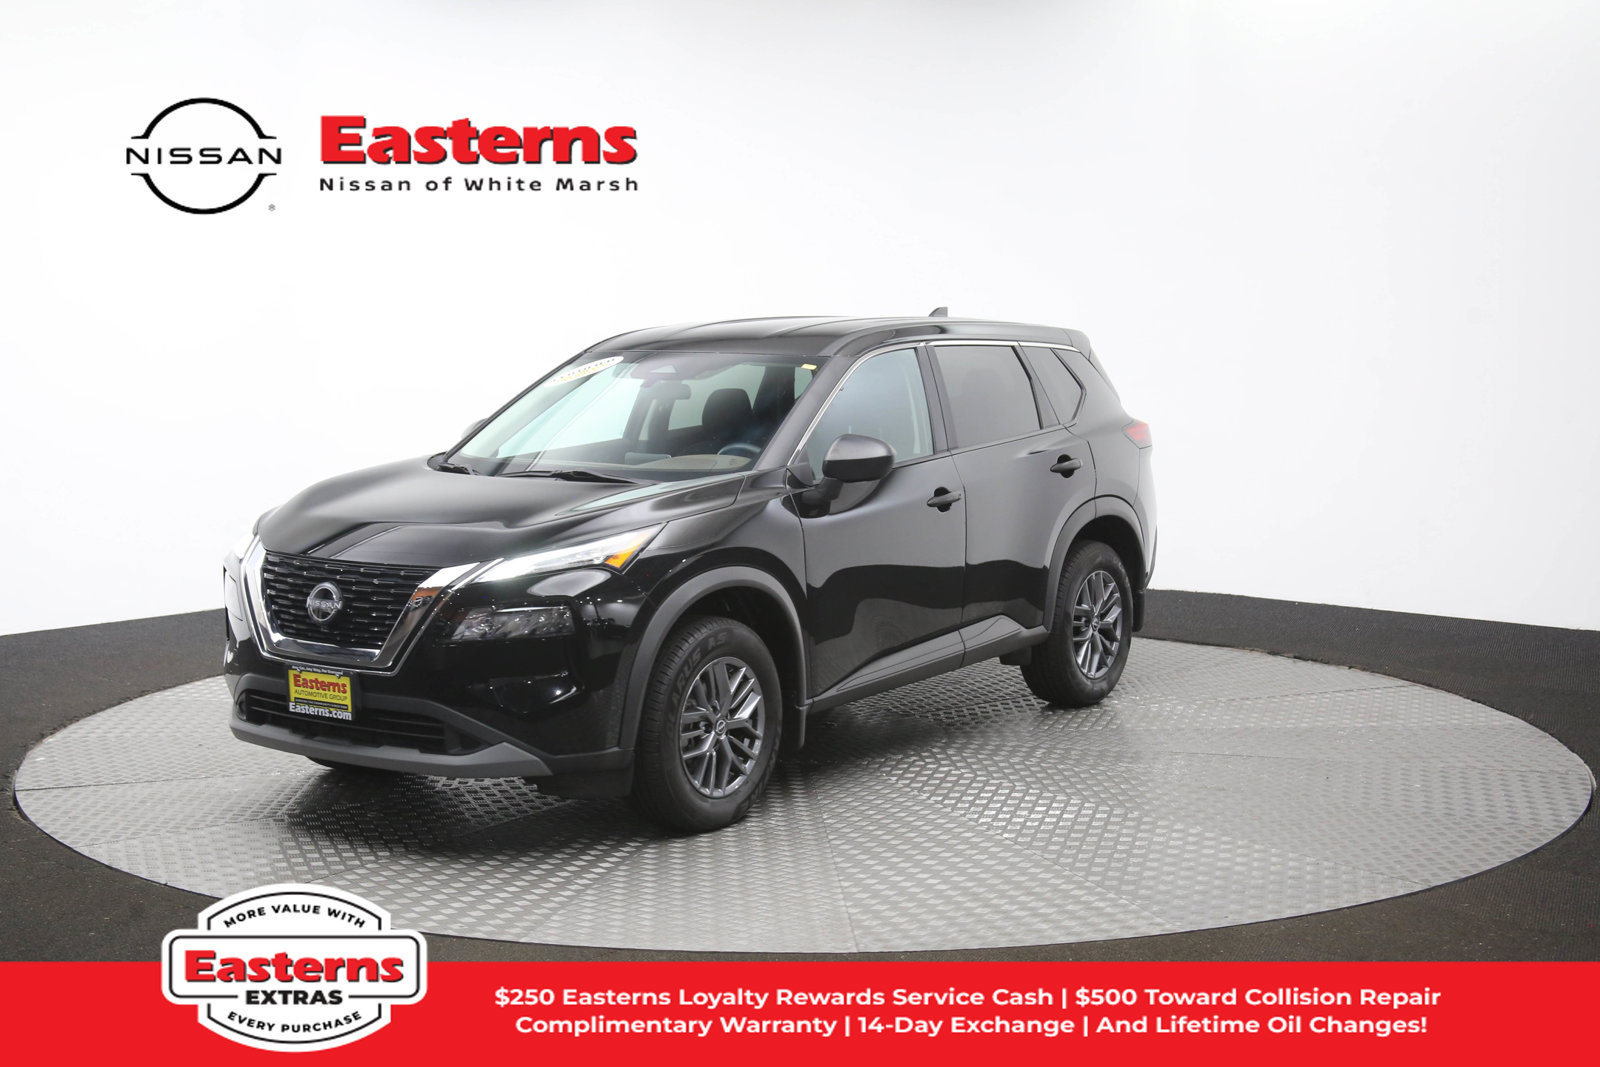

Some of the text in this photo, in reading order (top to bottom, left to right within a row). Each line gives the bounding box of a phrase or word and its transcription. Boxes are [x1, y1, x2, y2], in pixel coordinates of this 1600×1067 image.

[306, 597, 343, 609] NISSAN
[293, 673, 347, 694] Easterns
[294, 689, 328, 699] AUTOMOTIVE
[666, 647, 701, 745] OLARUS
[289, 702, 352, 721] Easterns.com
